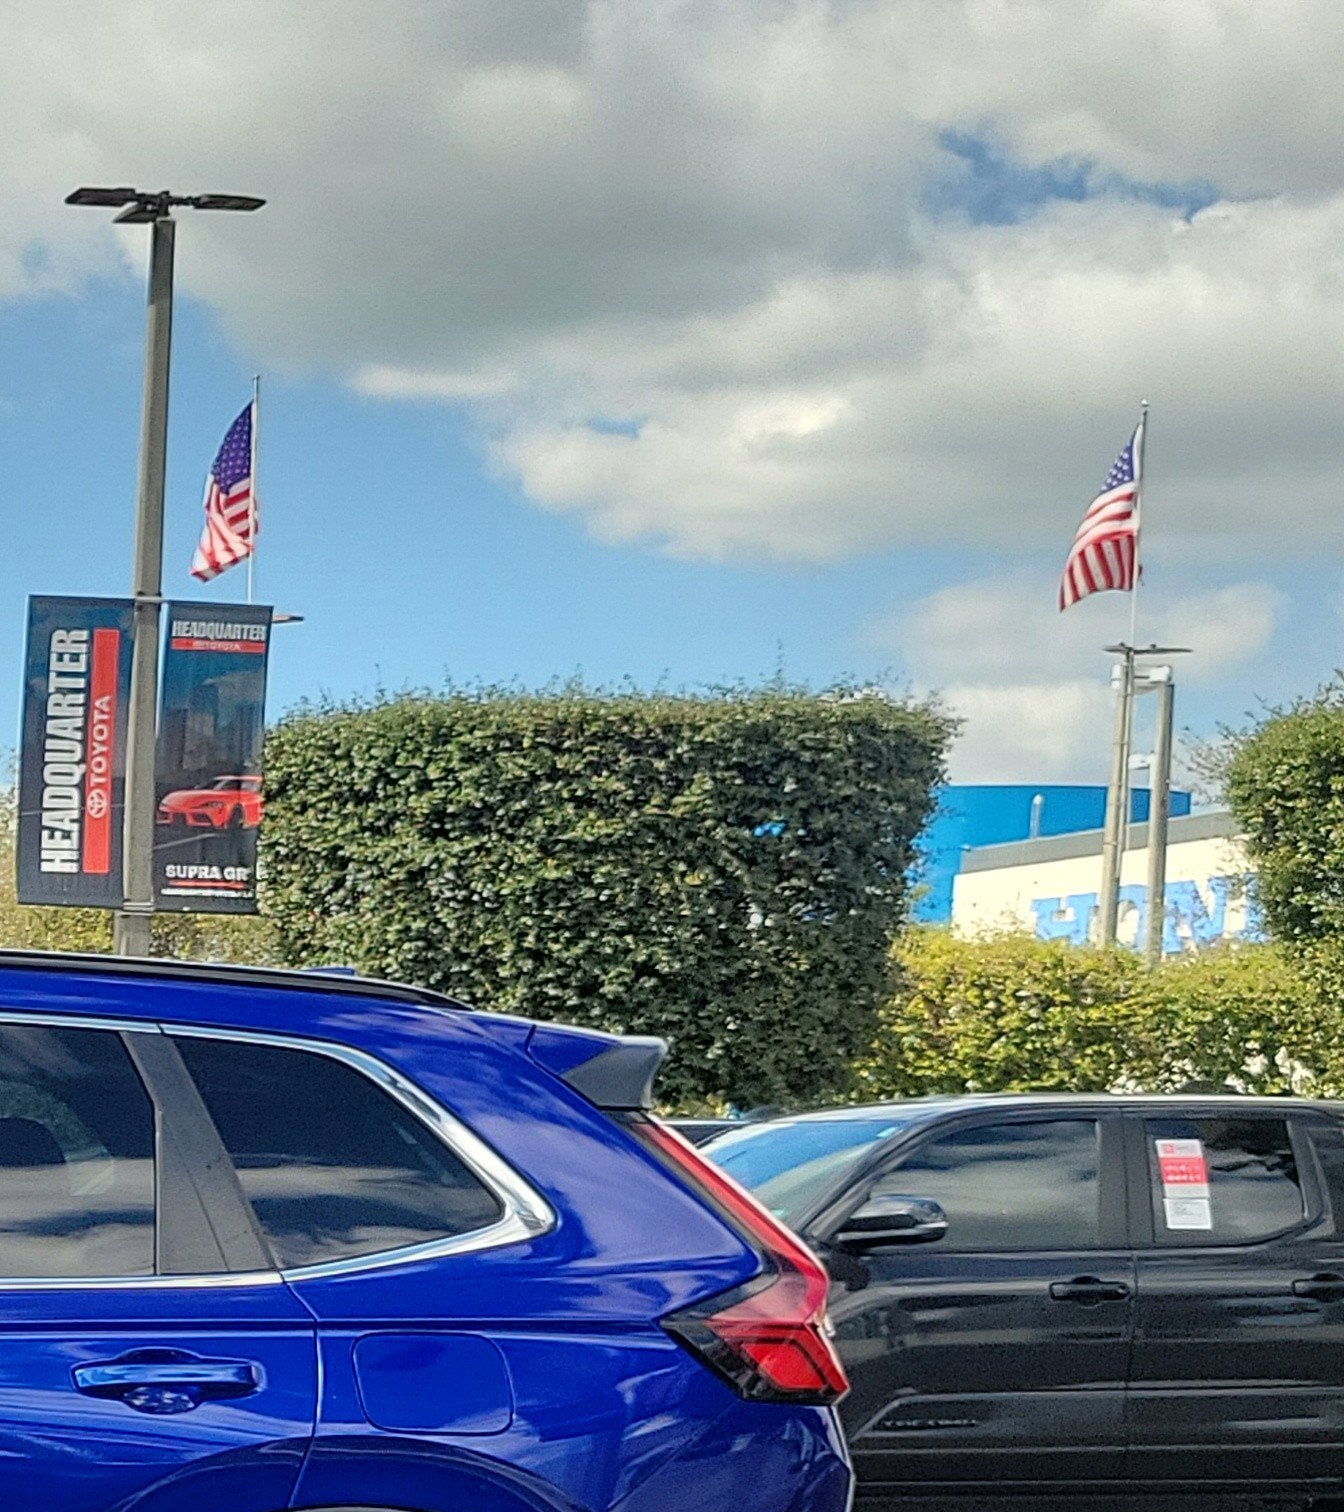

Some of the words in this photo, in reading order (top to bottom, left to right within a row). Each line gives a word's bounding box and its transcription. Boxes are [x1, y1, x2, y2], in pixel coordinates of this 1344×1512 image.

[172, 620, 267, 640] HEADQUARTER
[40, 628, 89, 873] HEADQUARTER
[89, 695, 111, 786] TOYOTA
[165, 865, 222, 879] SUPRA
